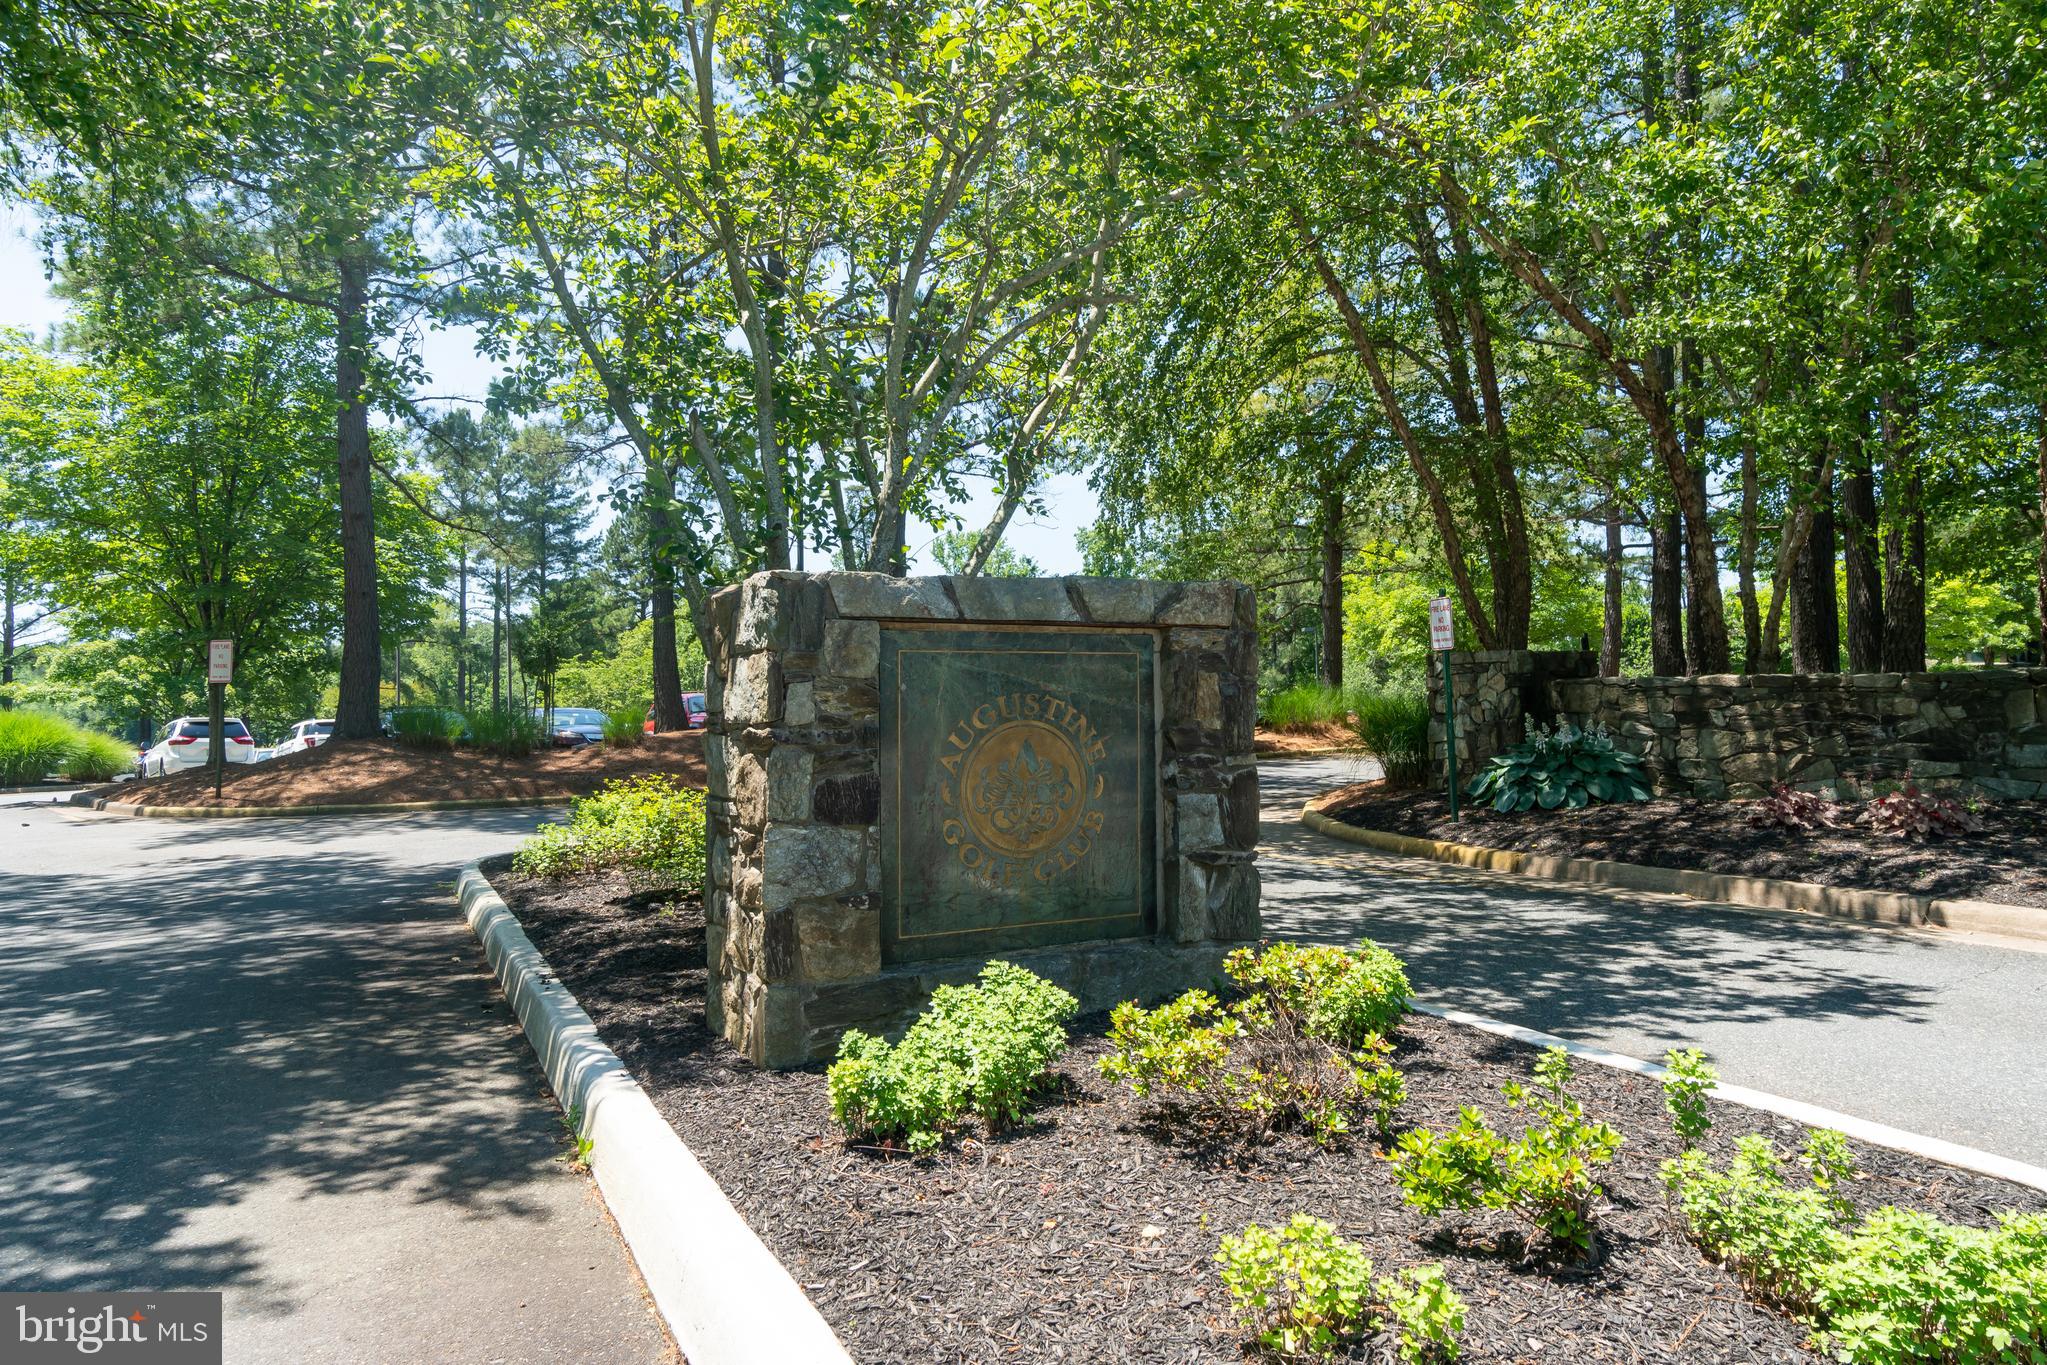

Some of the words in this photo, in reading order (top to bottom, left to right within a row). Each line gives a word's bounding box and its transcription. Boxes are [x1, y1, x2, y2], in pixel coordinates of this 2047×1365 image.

[940, 692, 1107, 778] AUGUSTINE
[943, 818, 1023, 885] GOLF
[1034, 810, 1105, 881] CLUB
